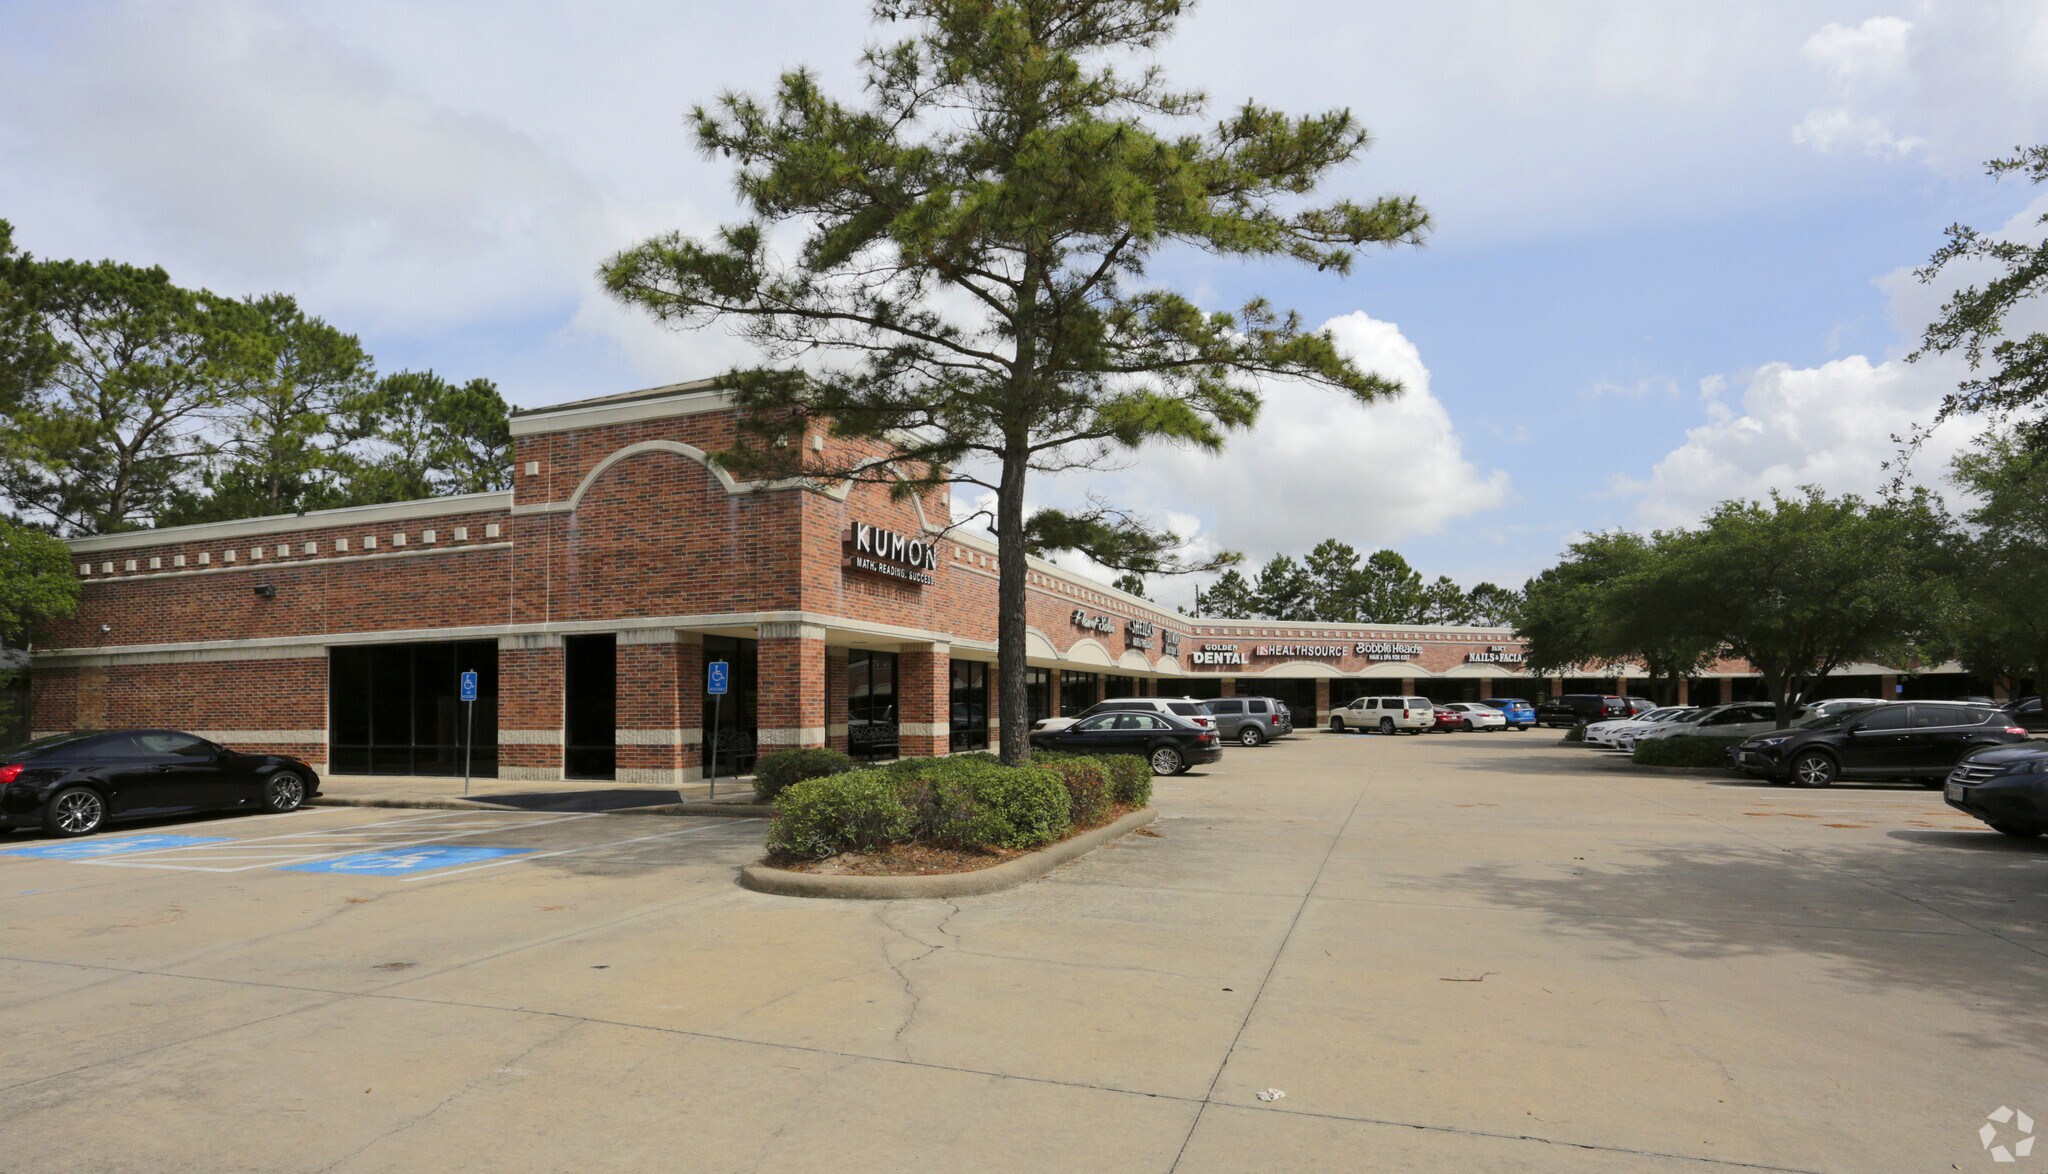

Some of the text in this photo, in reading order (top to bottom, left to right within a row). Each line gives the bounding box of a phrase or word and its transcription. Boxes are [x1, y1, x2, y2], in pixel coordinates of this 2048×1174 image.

[857, 521, 937, 570] KUMON
[856, 557, 877, 572] MATH.
[878, 563, 907, 578] READING.
[1268, 645, 1348, 657] HEALTHSOURCE
[1193, 652, 1249, 664] DENTAL
[1469, 653, 1494, 662] NAILS
[1499, 653, 1528, 662] FACIA
